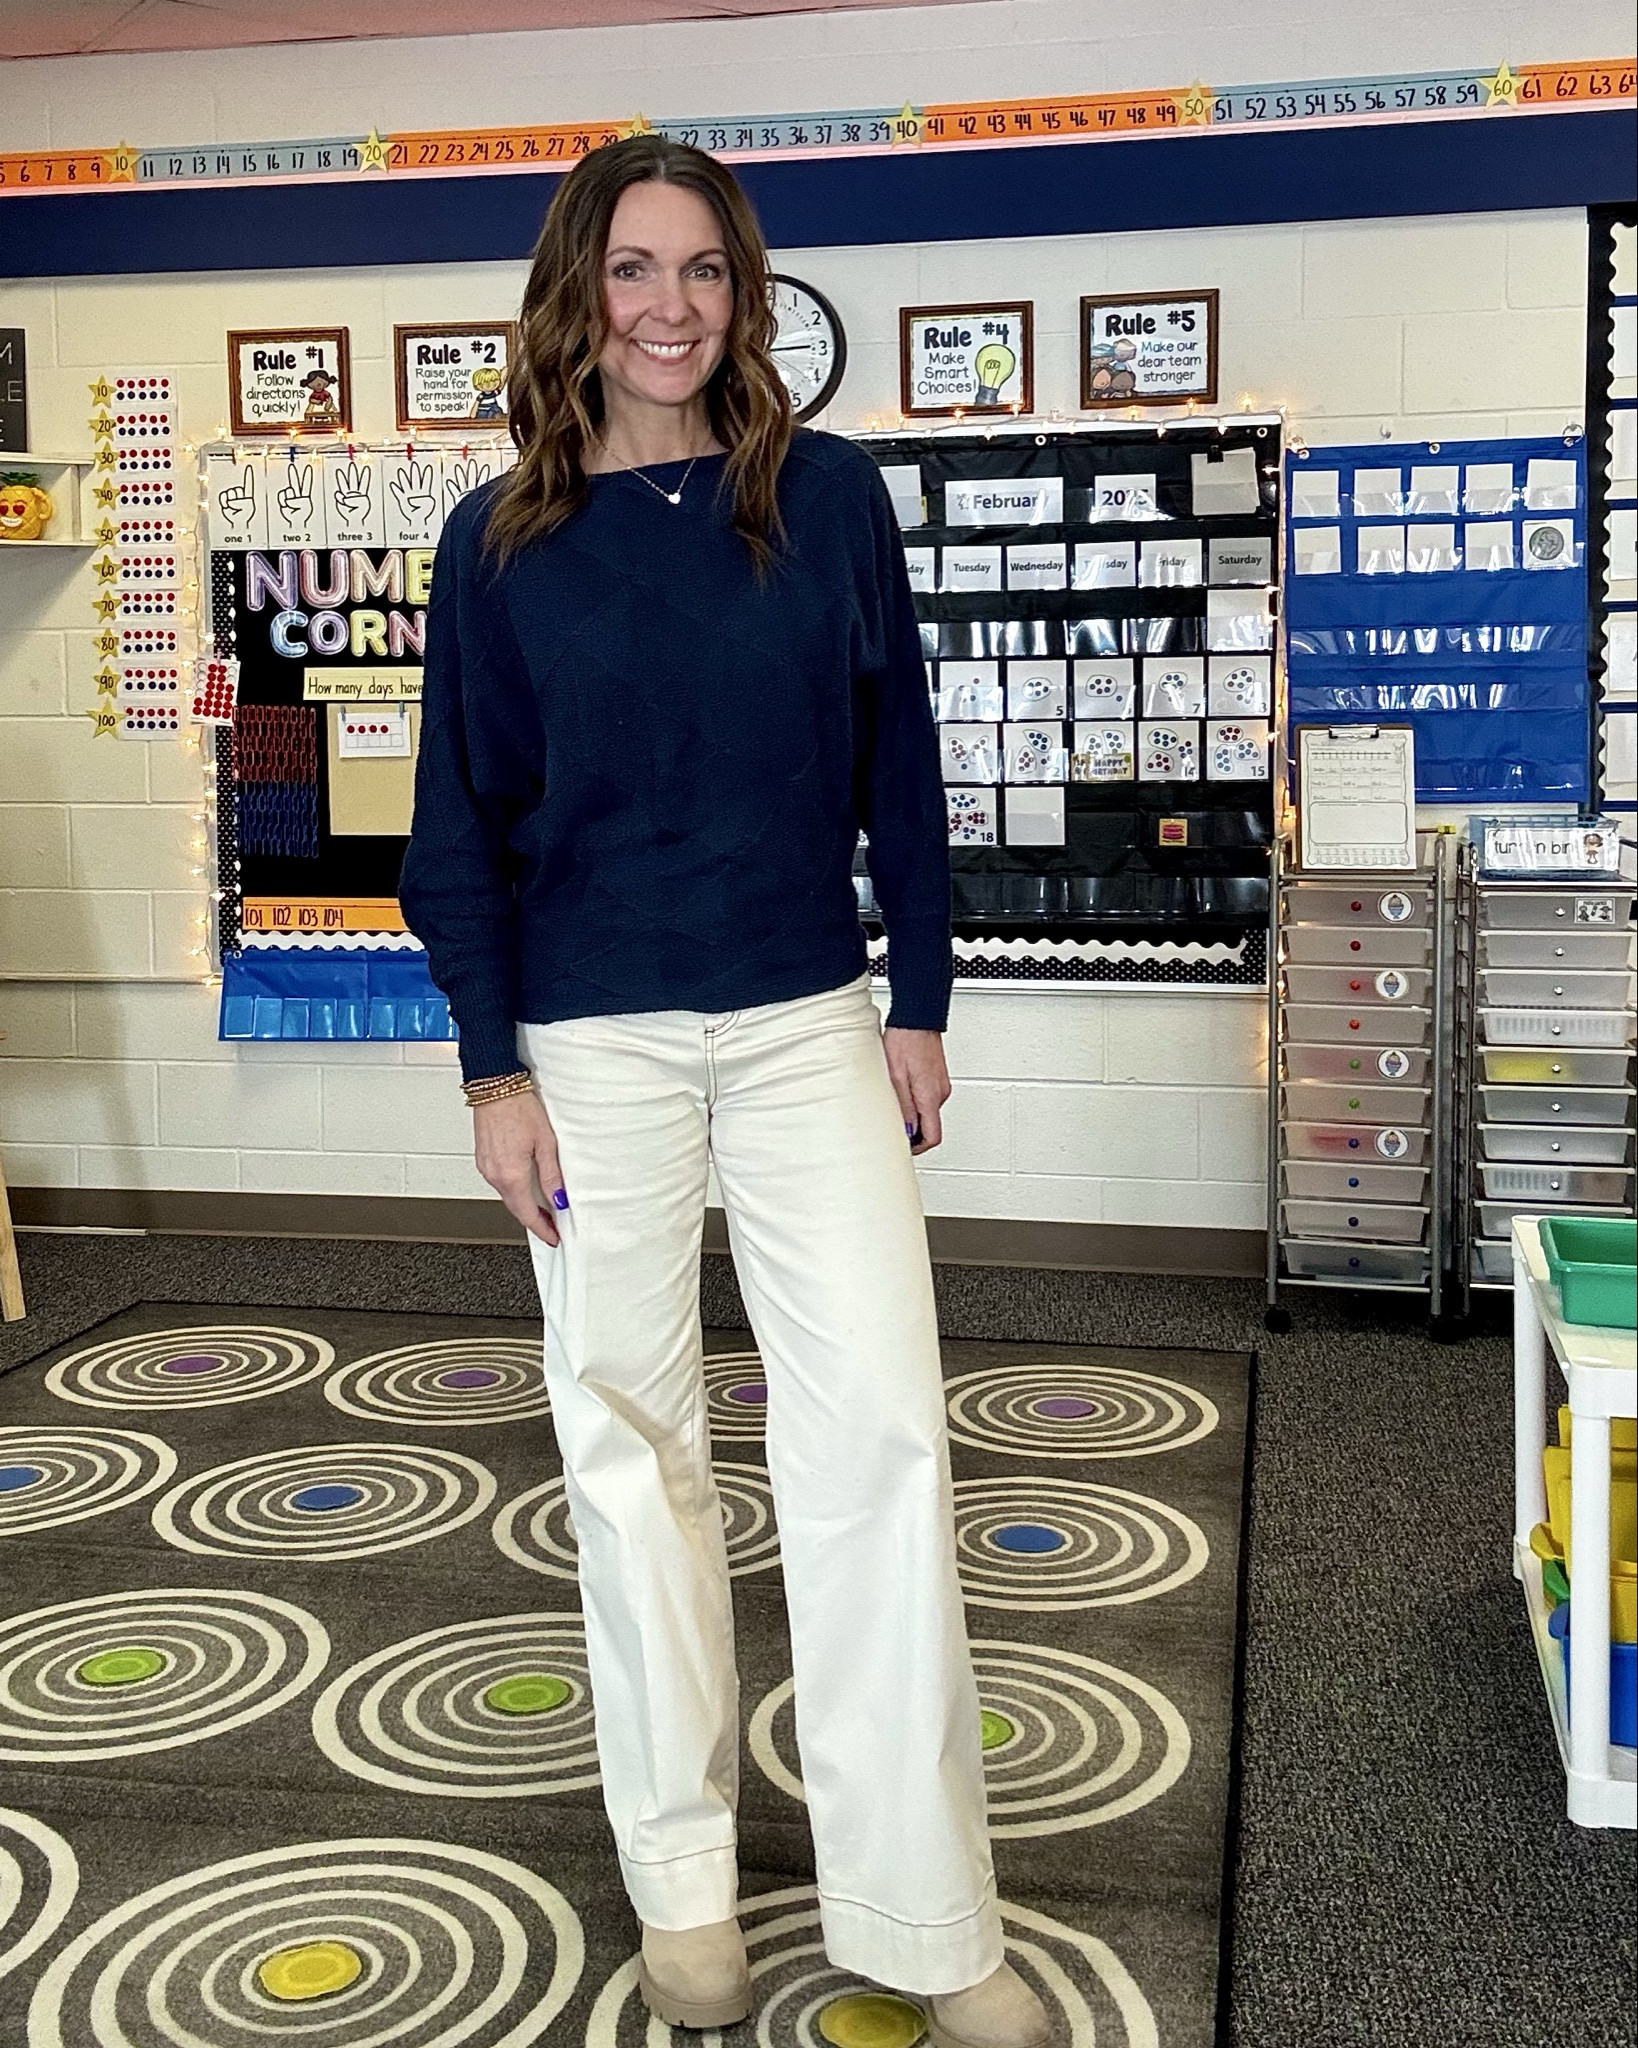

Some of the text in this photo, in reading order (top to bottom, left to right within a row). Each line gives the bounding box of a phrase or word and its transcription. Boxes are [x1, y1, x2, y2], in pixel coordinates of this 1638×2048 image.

[19, 160, 30, 182] 6
[45, 165, 52, 180] 7
[68, 165, 76, 180] 8
[91, 163, 100, 178] 9
[116, 156, 128, 170] 10
[144, 161, 153, 177] 11
[170, 159, 183, 175] 12
[194, 156, 206, 173] 13
[217, 156, 230, 174] 14
[243, 154, 256, 171] 15
[268, 154, 279, 170] 16
[293, 153, 304, 168] 17
[318, 151, 331, 168] 18
[343, 149, 358, 166] 19
[366, 145, 381, 161] 20
[389, 144, 407, 164] 21
[419, 145, 439, 163] 22
[445, 144, 464, 161] 23
[469, 143, 488, 160] 24
[495, 141, 514, 160] 25
[521, 140, 539, 157] 26
[546, 138, 564, 156] 27
[572, 136, 591, 156] 28
[708, 130, 726, 150] 33
[734, 129, 752, 147] 34
[760, 128, 779, 147] 35
[789, 127, 808, 145] 36
[814, 125, 831, 144] 37
[841, 124, 861, 142] 38
[870, 122, 890, 141] 39
[897, 120, 917, 138] 40
[928, 118, 943, 135] 41
[959, 116, 977, 134] 42
[988, 115, 1005, 133] 43
[1015, 114, 1031, 130] 44
[1042, 112, 1060, 129] 45
[1070, 112, 1088, 127] 46
[1098, 110, 1116, 126] 47
[1127, 108, 1146, 124] 48
[1157, 105, 1175, 123] 49
[1186, 99, 1203, 116] 50
[1216, 99, 1232, 120] 51
[1246, 98, 1266, 119] 52
[1276, 97, 1296, 118] 53
[1305, 94, 1325, 115] 54
[1334, 93, 1356, 113] 55
[1365, 91, 1385, 109] 56
[1395, 89, 1415, 107] 57
[1425, 86, 1446, 106] 58
[1456, 84, 1478, 103] 59
[1494, 80, 1512, 96] 60
[1523, 79, 1541, 98] 61
[1556, 76, 1577, 96] 62
[1590, 75, 1611, 94] 63
[794, 293, 797, 307] 1
[811, 310, 821, 325] 2
[1105, 310, 1195, 337] Rule #5
[924, 321, 1009, 349] Rule #4
[417, 340, 496, 365] Rule #2
[819, 340, 827, 356] 3
[1141, 341, 1198, 352] Make our
[253, 345, 324, 371] Rule #1
[929, 352, 965, 365] Make
[1138, 355, 1201, 368] dear team
[257, 373, 294, 386] Follow
[416, 368, 471, 380] Raise your
[814, 368, 821, 383] 4
[925, 367, 969, 379] Smart
[1144, 370, 1195, 384] stronger
[423, 378, 468, 390] hand for
[918, 379, 977, 395] Choices!
[97, 385, 107, 397] 10
[246, 386, 306, 400] directions
[416, 390, 473, 402] permission
[793, 393, 801, 407] 5
[252, 400, 301, 417] quickly!
[420, 400, 469, 414] to speak!
[98, 420, 113, 432] 20
[101, 452, 114, 464] 30
[100, 490, 113, 501] 40
[973, 494, 1048, 509] Februar
[100, 529, 113, 541] 50
[338, 532, 372, 541] three 3
[399, 532, 419, 540] four
[1010, 560, 1063, 574] Wednesday
[1084, 558, 1127, 570] Tsday
[1218, 555, 1262, 566] Saturday
[102, 563, 114, 577] 60
[954, 564, 991, 574] Tuesday
[101, 600, 114, 612] 70
[101, 637, 114, 651] 80
[100, 676, 114, 689] 90
[308, 677, 331, 694] How
[335, 682, 361, 699] many
[369, 678, 394, 699] days
[1056, 706, 1063, 716] 5
[1192, 703, 1201, 713] 7
[99, 715, 115, 727] 100
[1251, 766, 1265, 776] 15
[980, 833, 994, 842] 18
[1494, 841, 1522, 853] tur
[245, 908, 344, 927] 101 102 103 104
